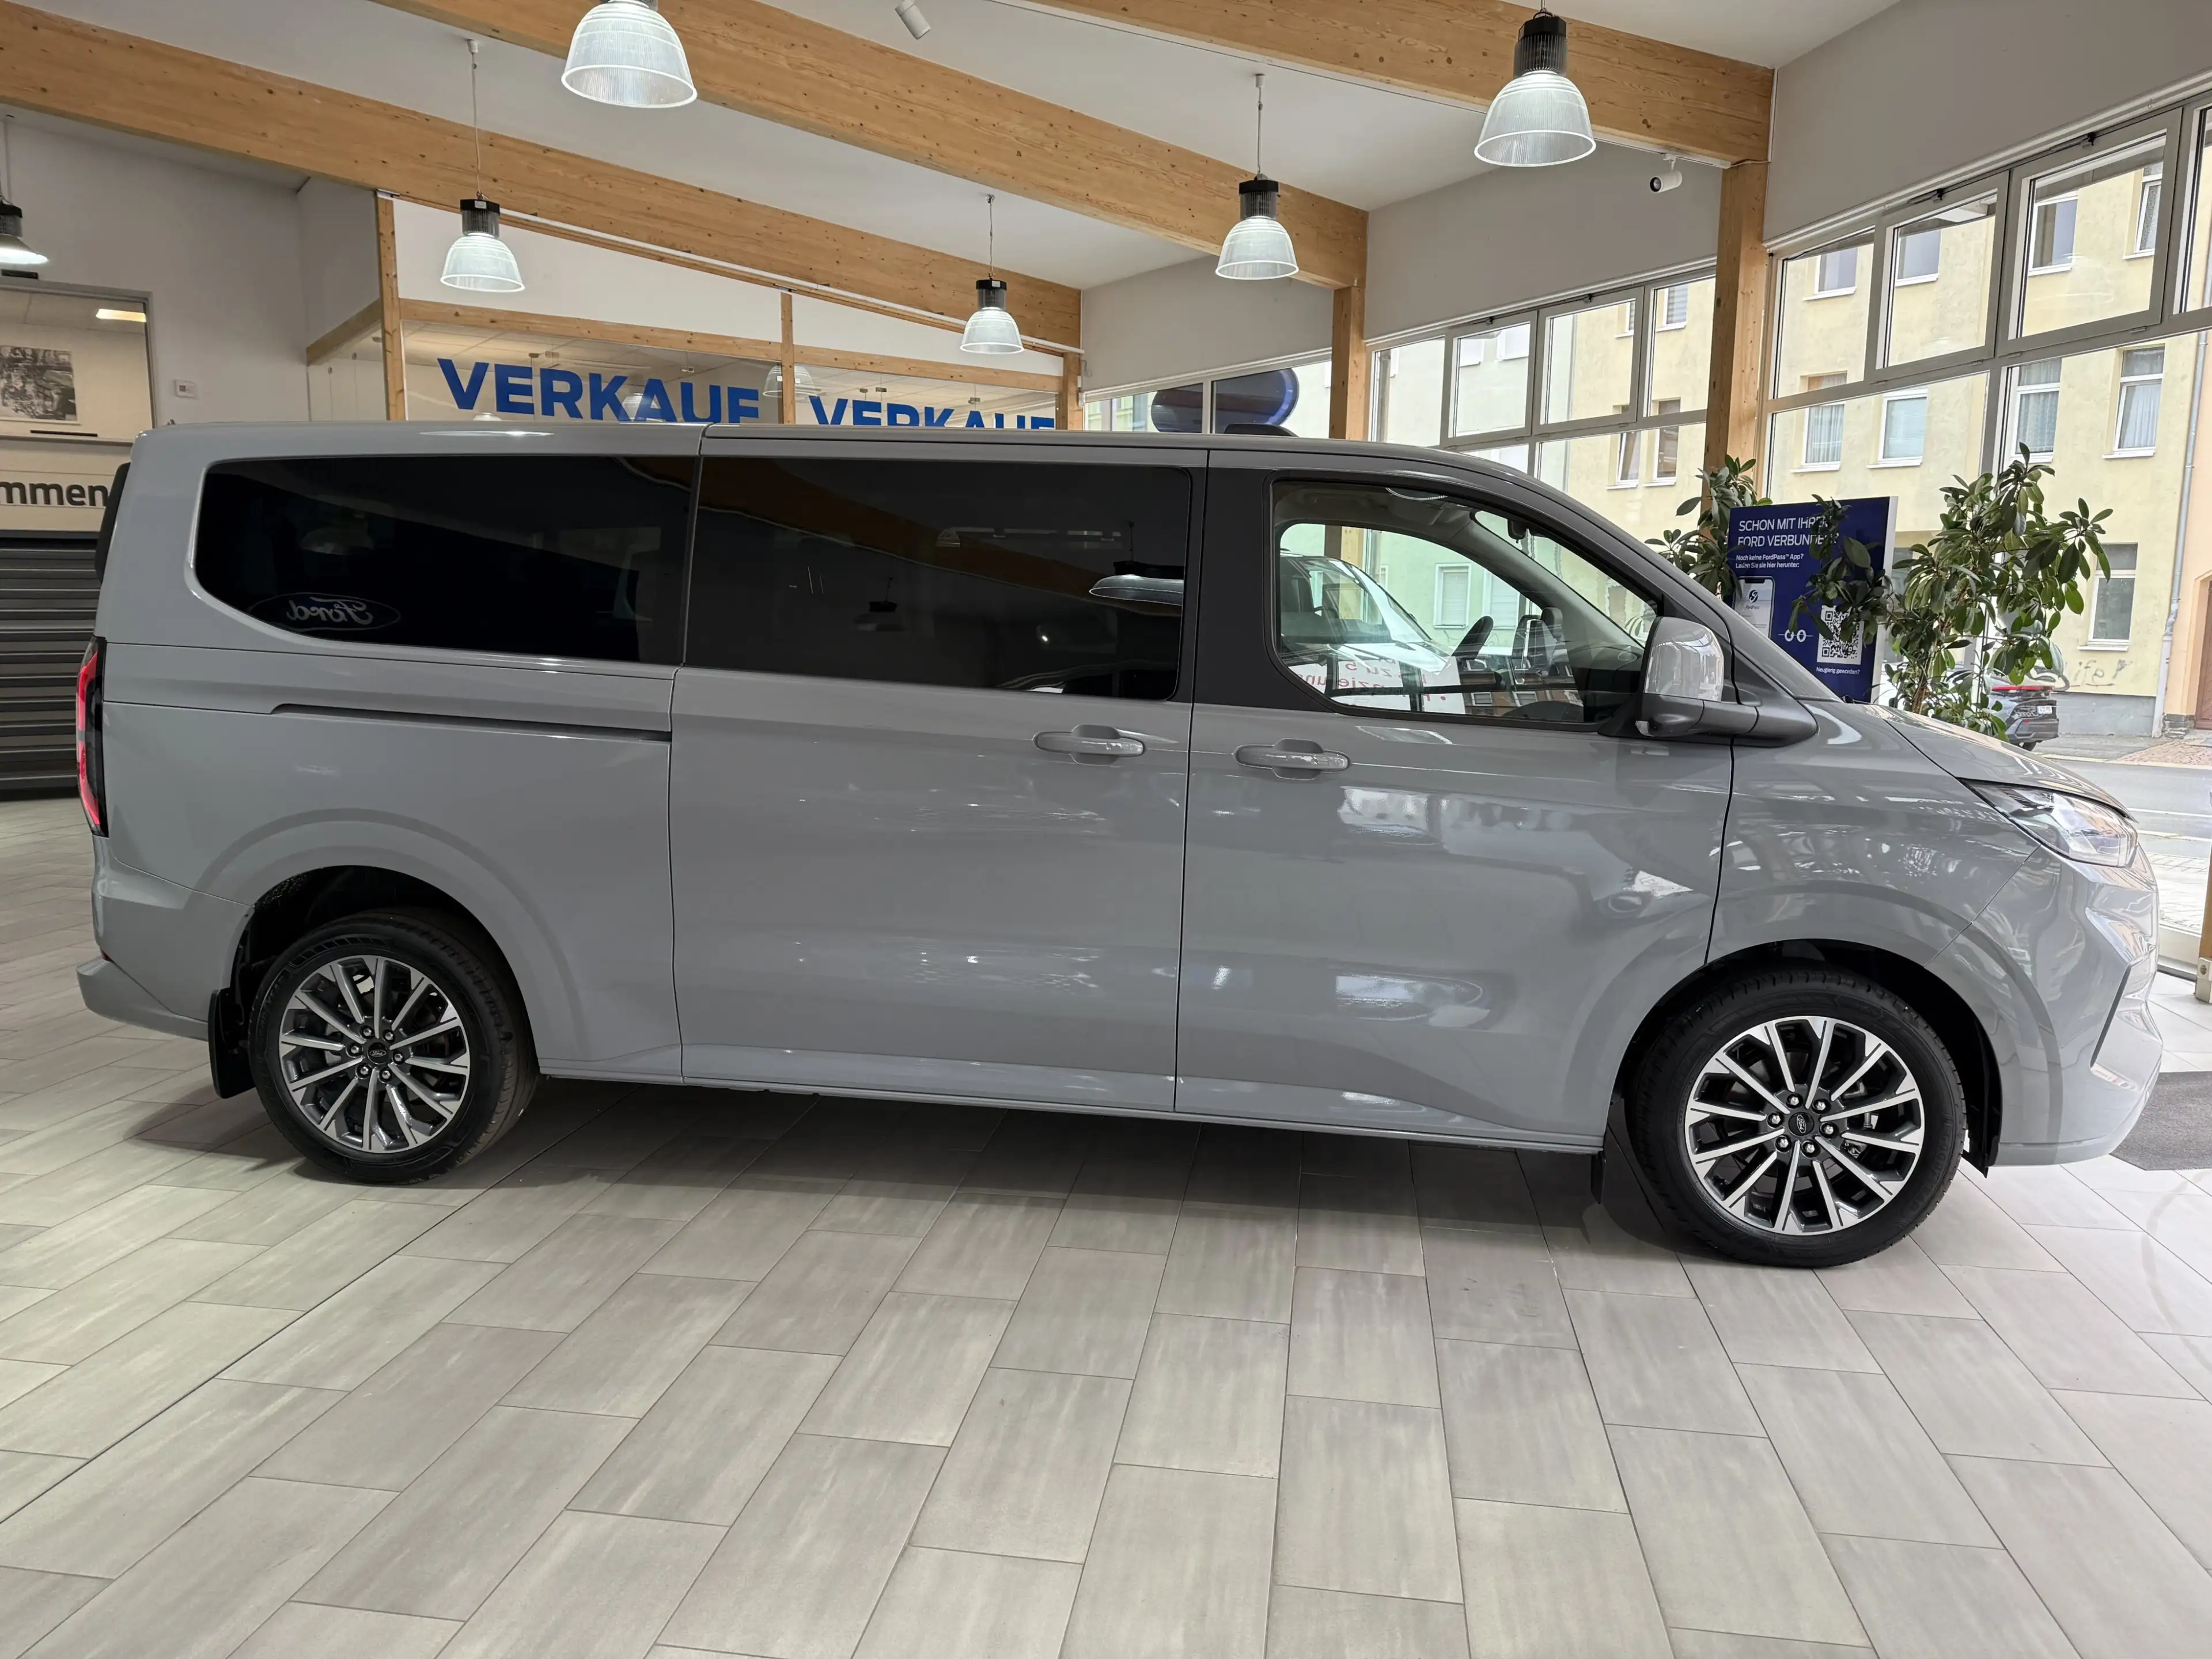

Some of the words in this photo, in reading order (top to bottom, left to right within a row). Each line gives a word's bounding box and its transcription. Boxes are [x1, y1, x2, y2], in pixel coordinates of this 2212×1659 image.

[437, 358, 759, 424] VERKAUF
[1738, 520, 1775, 532] SCHON
[1777, 518, 1796, 530] MIT
[1737, 535, 1765, 547] FORD
